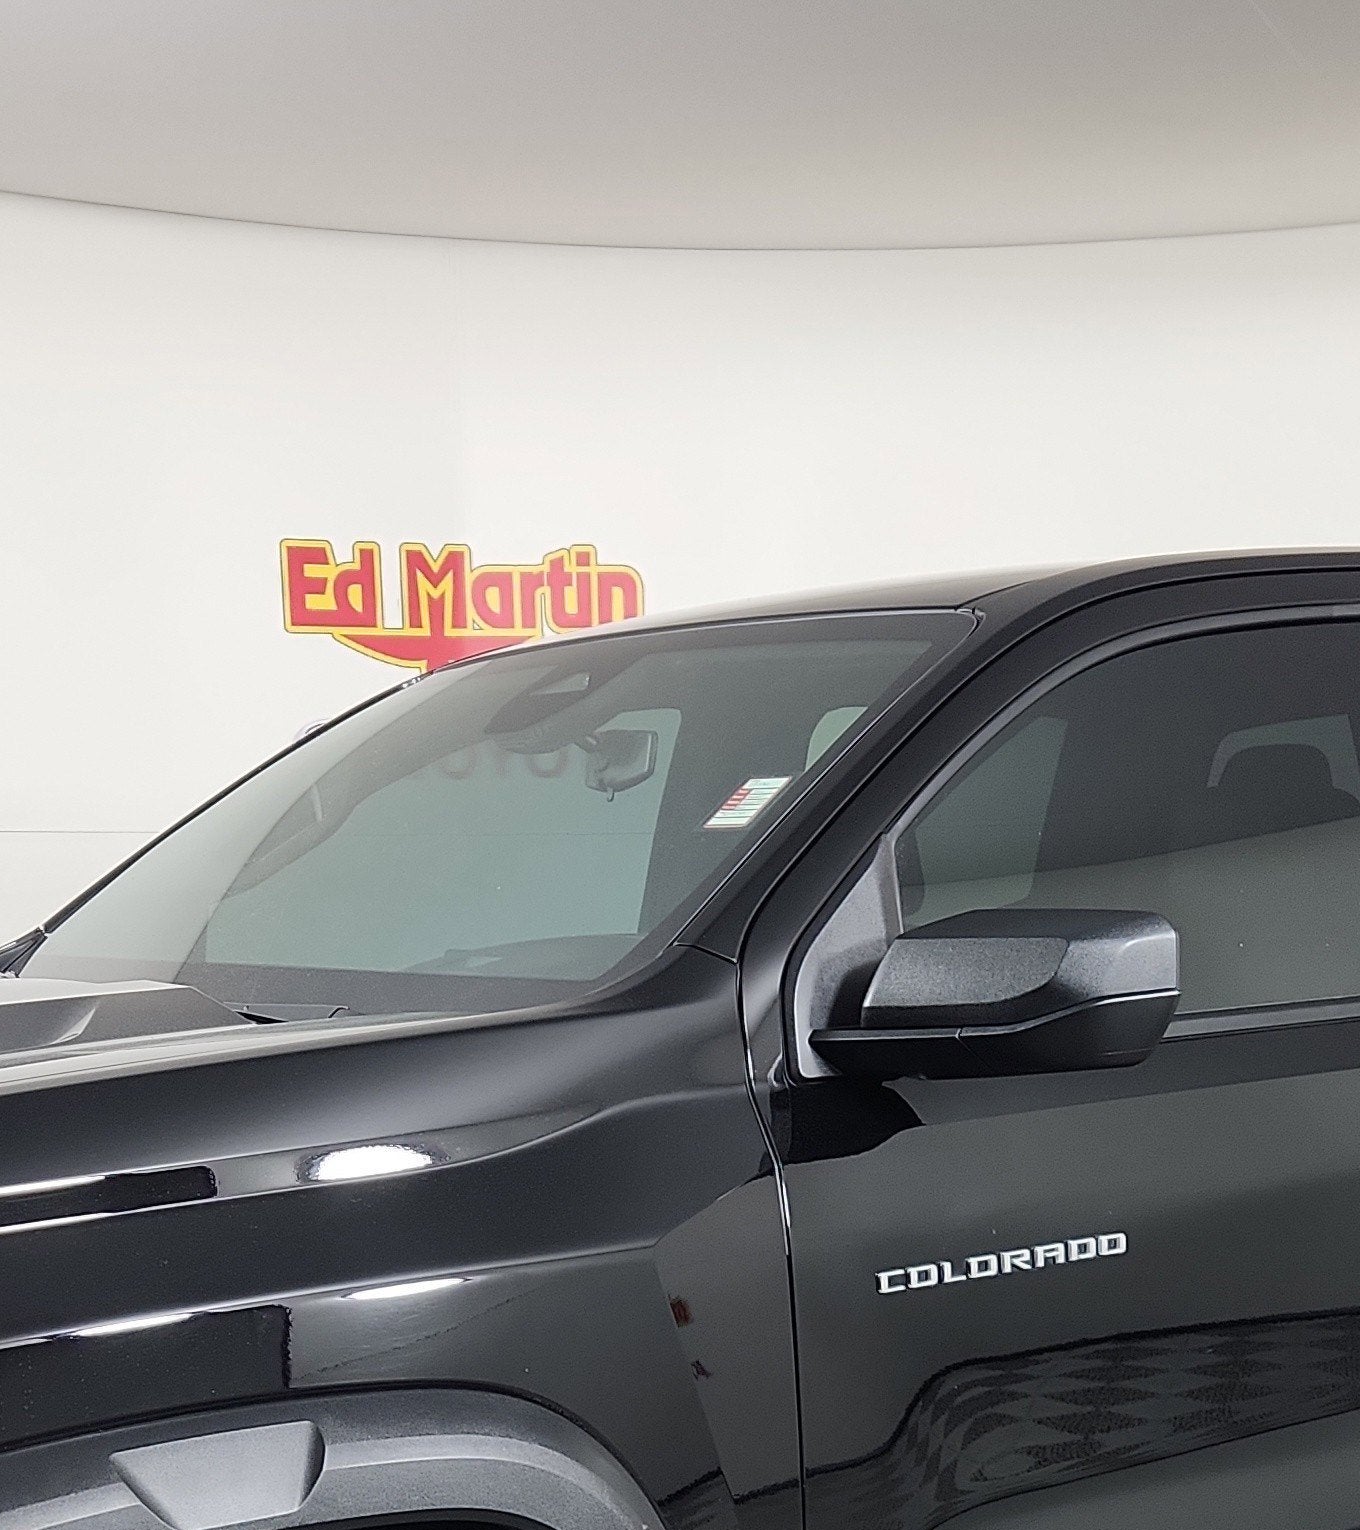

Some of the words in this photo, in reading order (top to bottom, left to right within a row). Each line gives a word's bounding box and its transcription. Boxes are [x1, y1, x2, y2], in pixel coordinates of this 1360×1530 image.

[283, 543, 380, 629] Ed
[404, 547, 641, 631] Martin
[875, 1232, 1127, 1294] COLORADO
